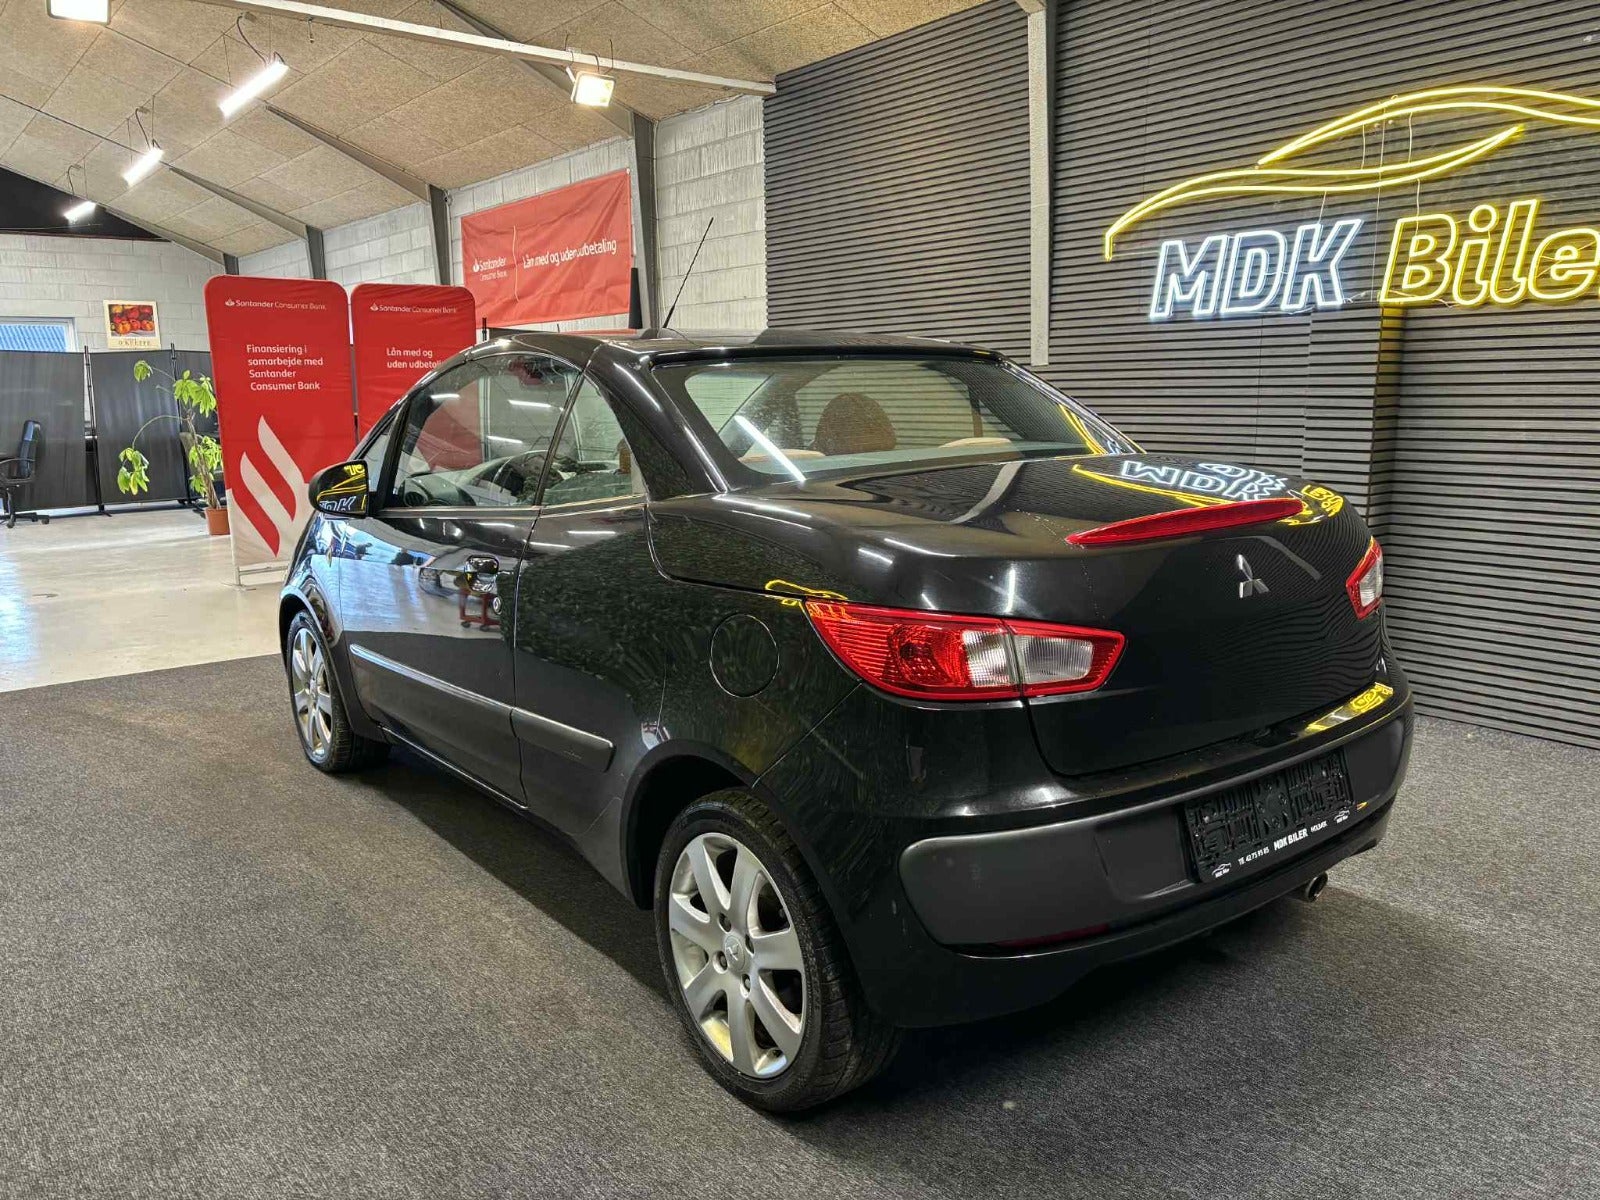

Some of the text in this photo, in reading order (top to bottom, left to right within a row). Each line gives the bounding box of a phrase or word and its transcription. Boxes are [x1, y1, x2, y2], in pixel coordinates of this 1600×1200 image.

[549, 251, 560, 267] og
[1149, 198, 1600, 319] MDK Bile
[235, 299, 273, 308] Santander
[274, 301, 308, 310] Consumer
[379, 304, 411, 313] Santander
[246, 343, 303, 356] Finansiering
[386, 347, 433, 359] Lån med og
[247, 356, 324, 368] samarbejde med
[386, 359, 408, 369] uden
[248, 369, 297, 379] Santander
[250, 380, 321, 391] Consumer Bank
[1273, 836, 1288, 851] MDK
[1287, 828, 1308, 845] BILER
